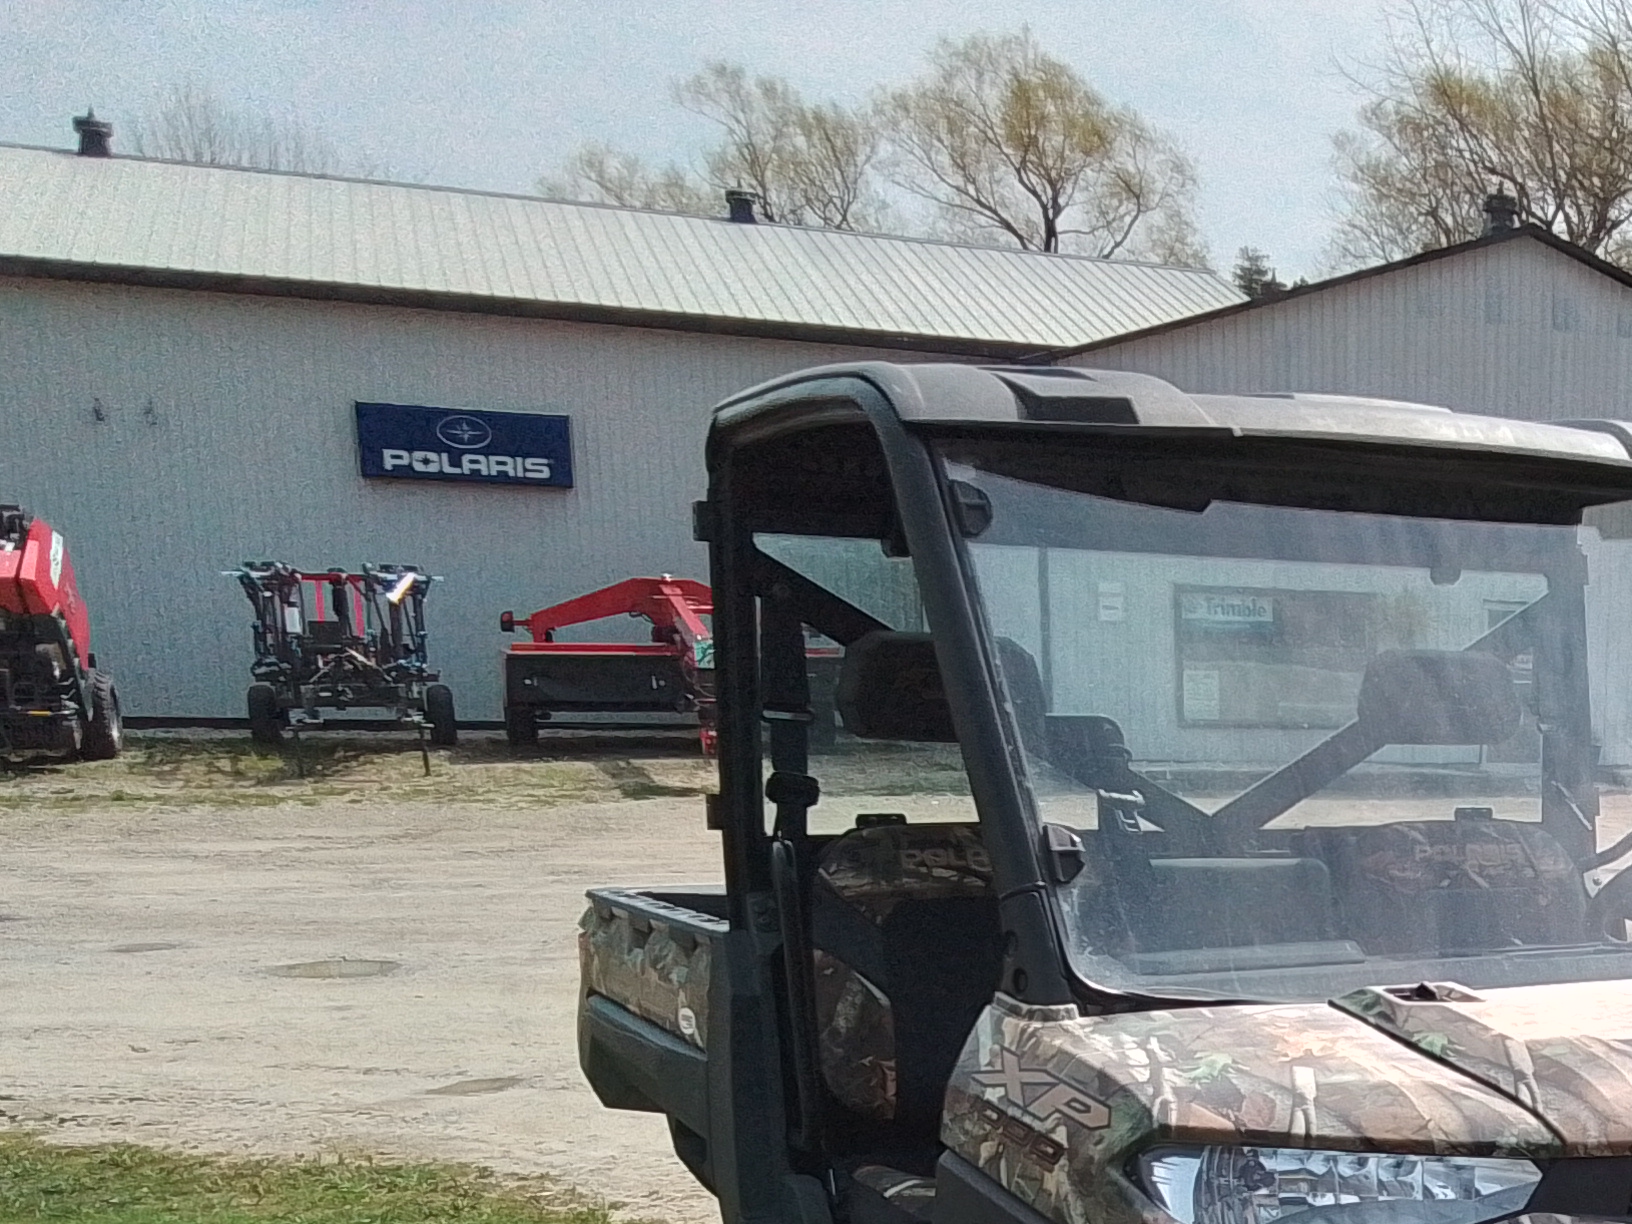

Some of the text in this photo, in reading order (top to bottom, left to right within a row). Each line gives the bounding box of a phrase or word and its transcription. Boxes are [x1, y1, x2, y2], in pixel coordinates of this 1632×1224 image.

[381, 448, 551, 480] POLARIS
[1204, 595, 1267, 618] Trimble
[969, 1043, 1112, 1130] XP
